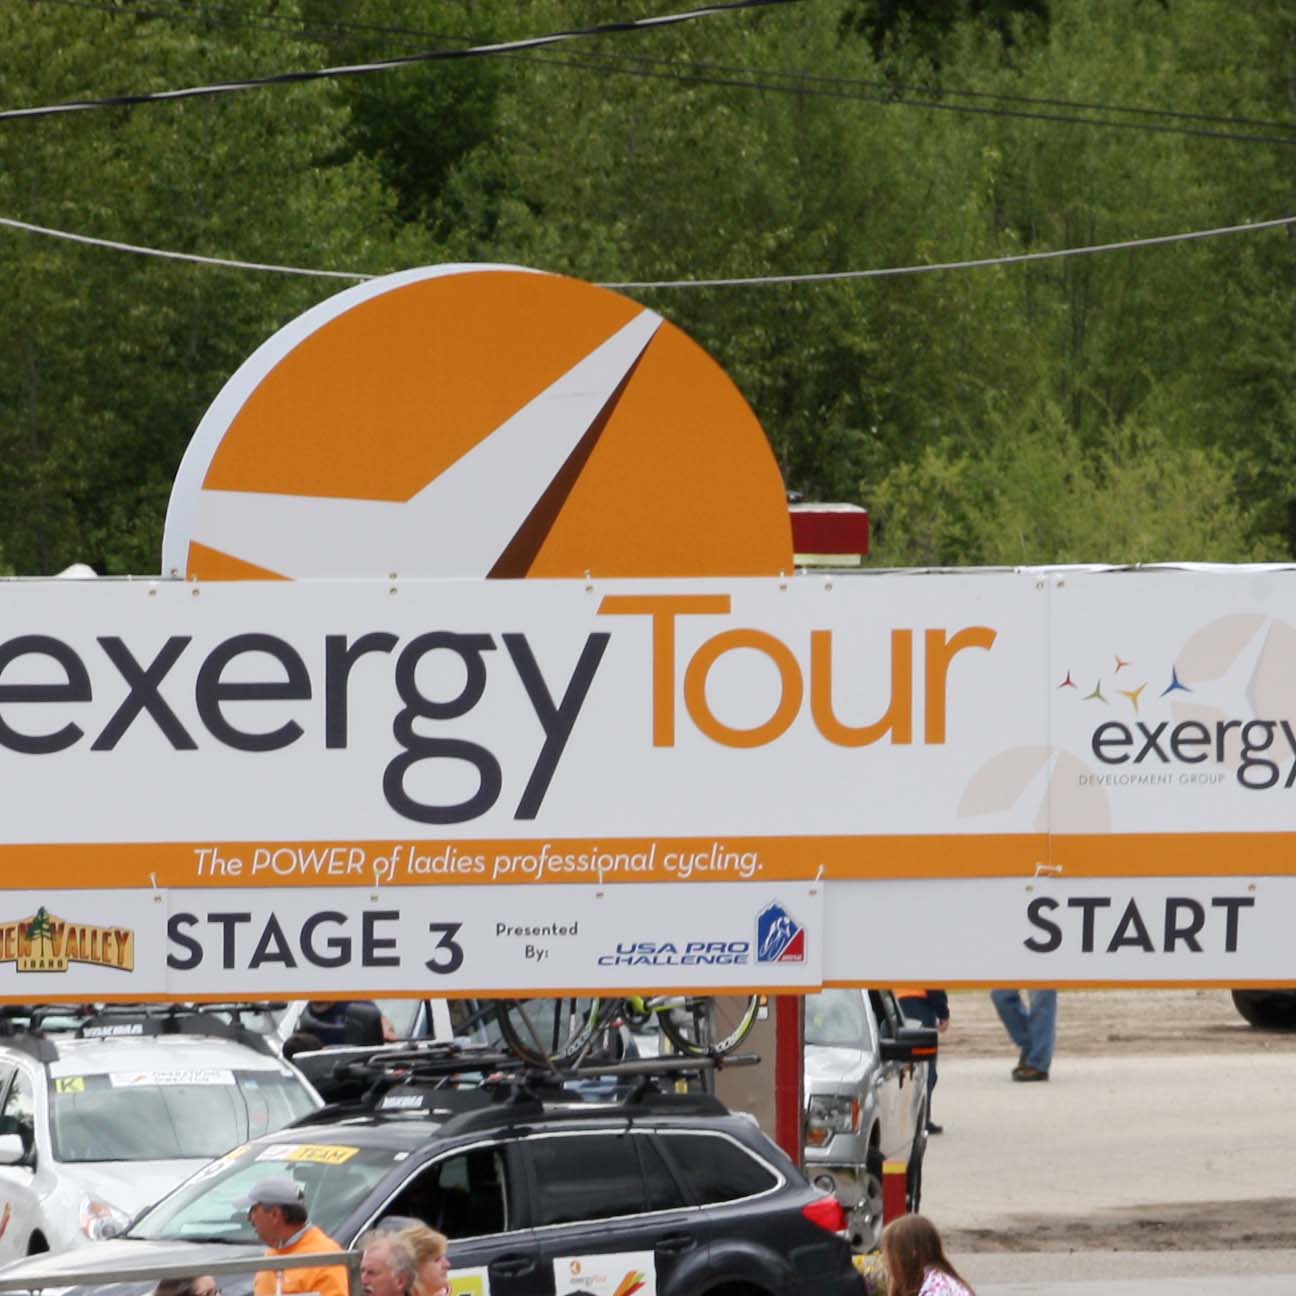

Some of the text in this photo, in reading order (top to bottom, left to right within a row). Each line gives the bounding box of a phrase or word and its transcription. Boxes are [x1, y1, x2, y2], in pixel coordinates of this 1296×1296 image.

[1078, 772, 1226, 787] DEVELOPMENT GROUP
[194, 844, 765, 888] The POWER of ladies professional cycling.
[495, 922, 580, 938] Presented
[1023, 895, 1256, 955] START
[50, 922, 130, 967] VALLEY
[167, 910, 465, 975] STAGE 3
[615, 940, 751, 956] USA PRO
[524, 945, 550, 963] By:
[596, 954, 750, 967] CHALLENGE
[23, 959, 64, 969] IDAHO
[298, 1147, 348, 1162] TEAM
